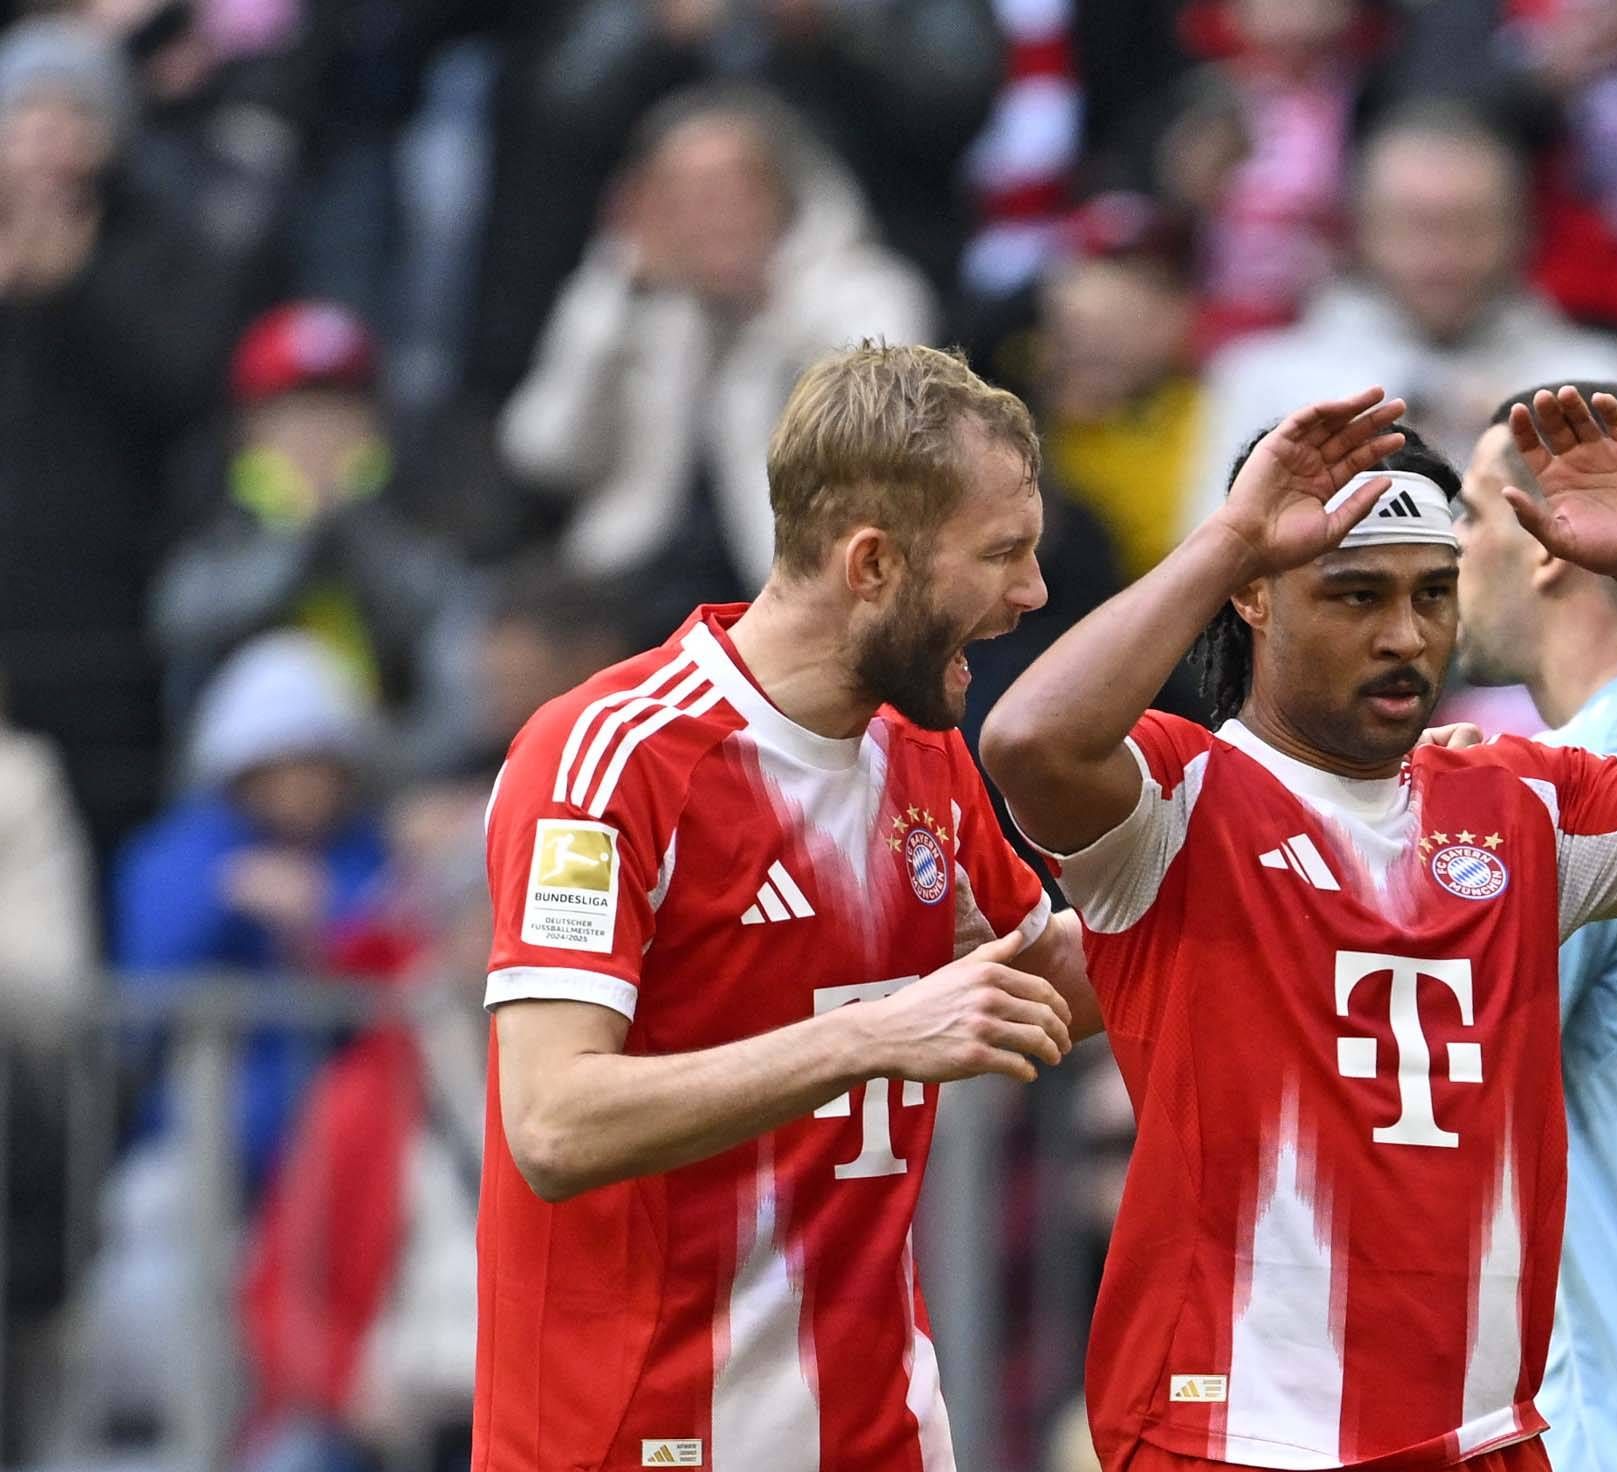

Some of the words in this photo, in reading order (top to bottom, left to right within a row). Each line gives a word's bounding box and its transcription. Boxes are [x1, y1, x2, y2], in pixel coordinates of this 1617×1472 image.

[910, 833, 940, 859] BAYERN
[1440, 848, 1492, 863] BAYERN
[1436, 861, 1448, 875] FC
[534, 891, 609, 908] BUNDESLIGA
[545, 916, 592, 928] DEUTSCHER
[530, 923, 605, 936] FUSSBALLMEISTER
[545, 932, 588, 943] 2024/2025
[1334, 950, 1483, 1149] T
